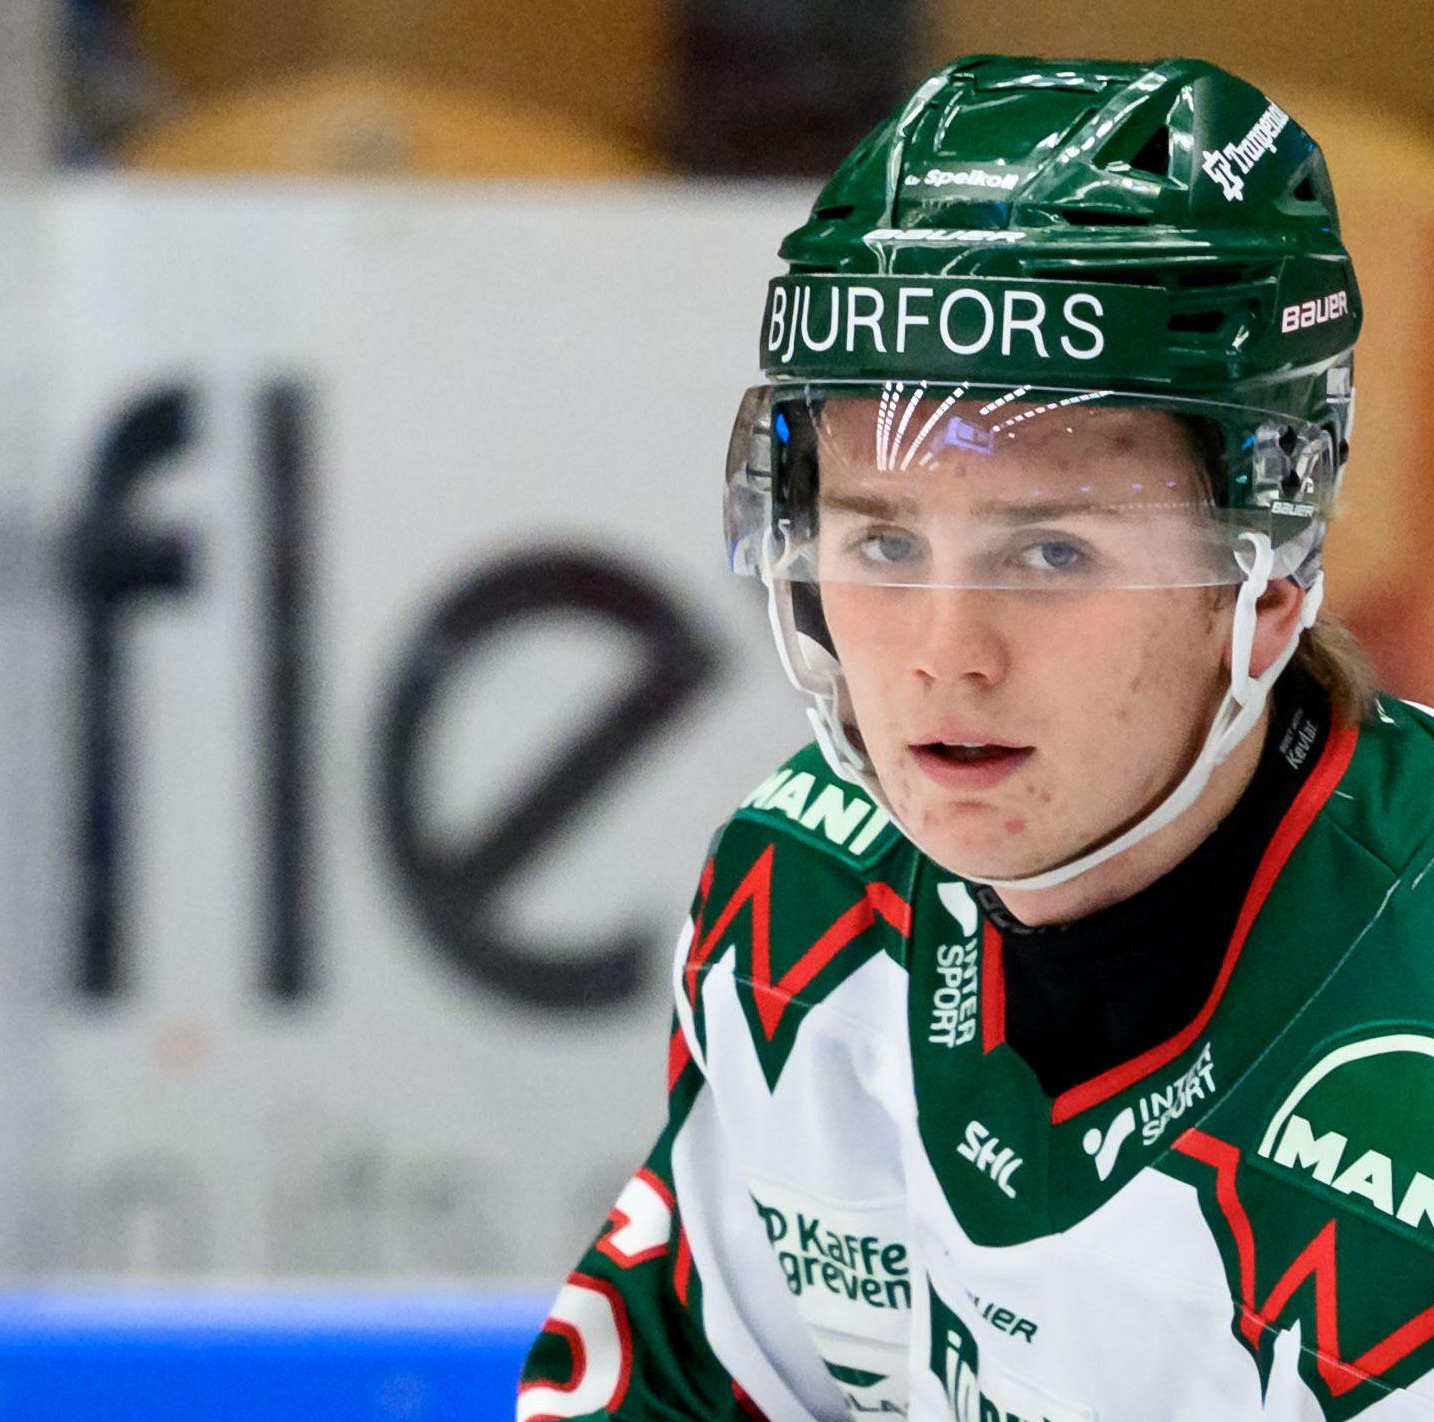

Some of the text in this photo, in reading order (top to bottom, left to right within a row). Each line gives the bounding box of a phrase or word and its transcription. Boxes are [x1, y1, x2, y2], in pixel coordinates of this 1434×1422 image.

[768, 287, 1105, 364] BJURFORS
[1282, 291, 1348, 333] BAUER
[1285, 720, 1318, 770] Kevlar
[928, 944, 965, 1048] SPORT
[956, 1120, 1024, 1199] SHL
[779, 1252, 912, 1310] greven
